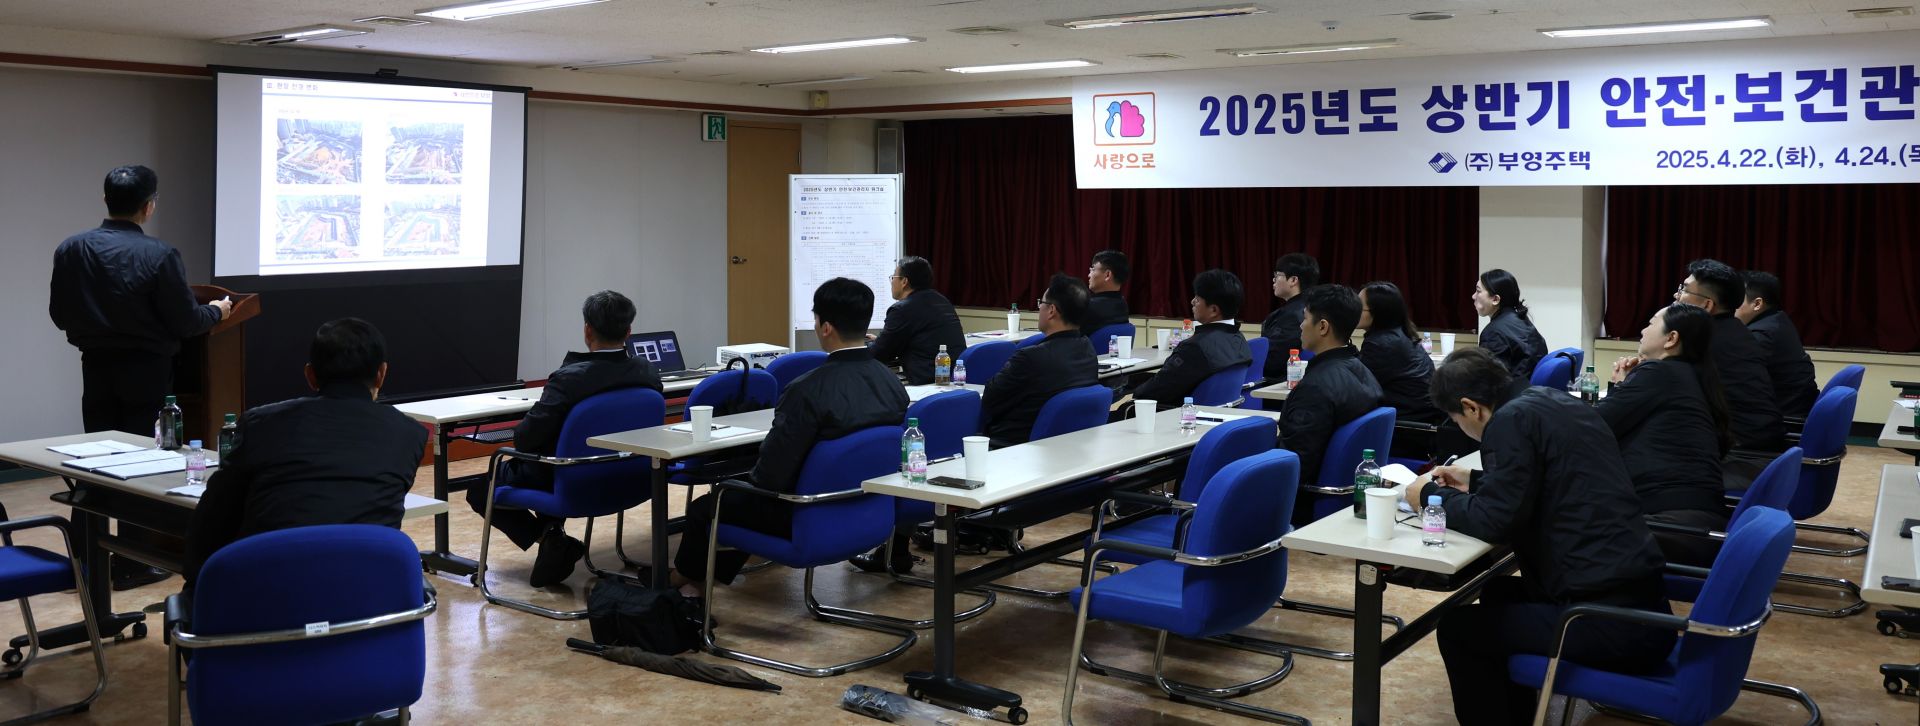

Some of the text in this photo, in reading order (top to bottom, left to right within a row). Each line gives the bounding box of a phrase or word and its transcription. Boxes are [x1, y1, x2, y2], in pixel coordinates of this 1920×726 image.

[1199, 88, 1398, 137] 2025년도
[1421, 80, 1570, 134] 상반기
[1093, 152, 1156, 170] 사랑으로
[1656, 145, 1824, 169] 2025.4.22.(화),
